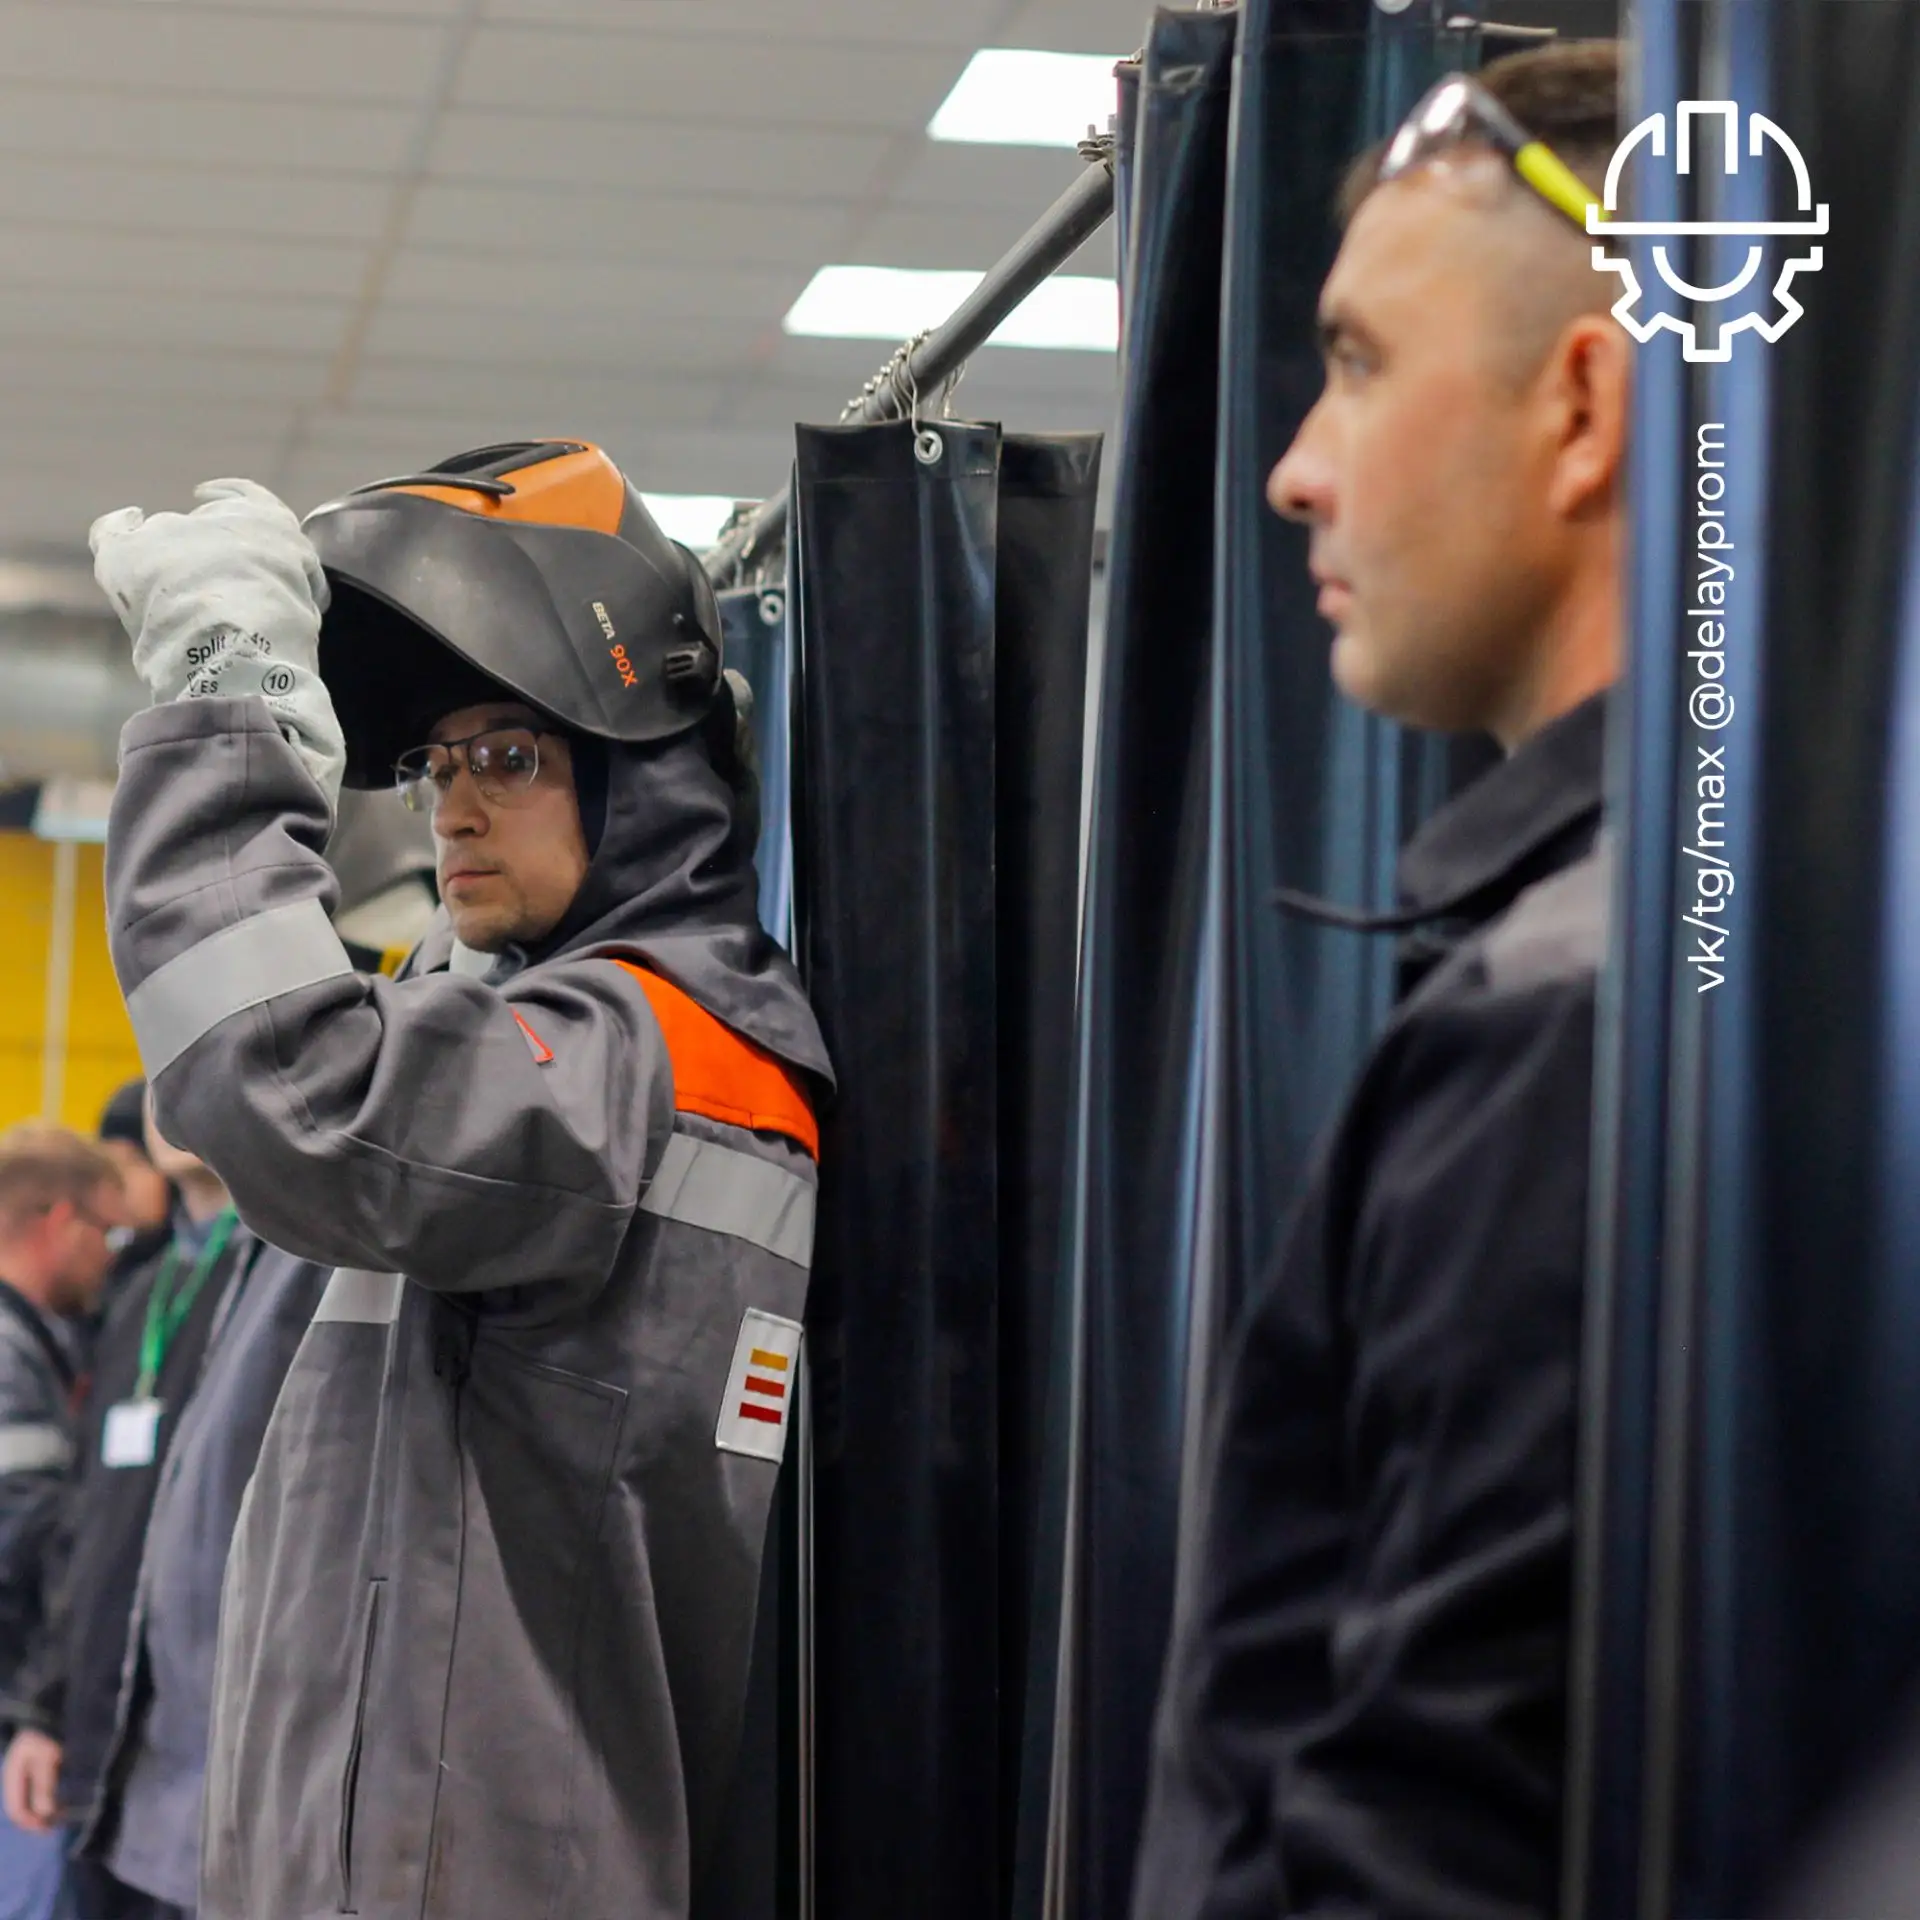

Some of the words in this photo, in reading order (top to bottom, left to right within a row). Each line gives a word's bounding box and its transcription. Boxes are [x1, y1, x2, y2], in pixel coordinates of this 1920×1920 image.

[186, 635, 227, 665] Split
[592, 601, 616, 640] BETA
[610, 644, 639, 688] 90X
[268, 673, 289, 690] 10
